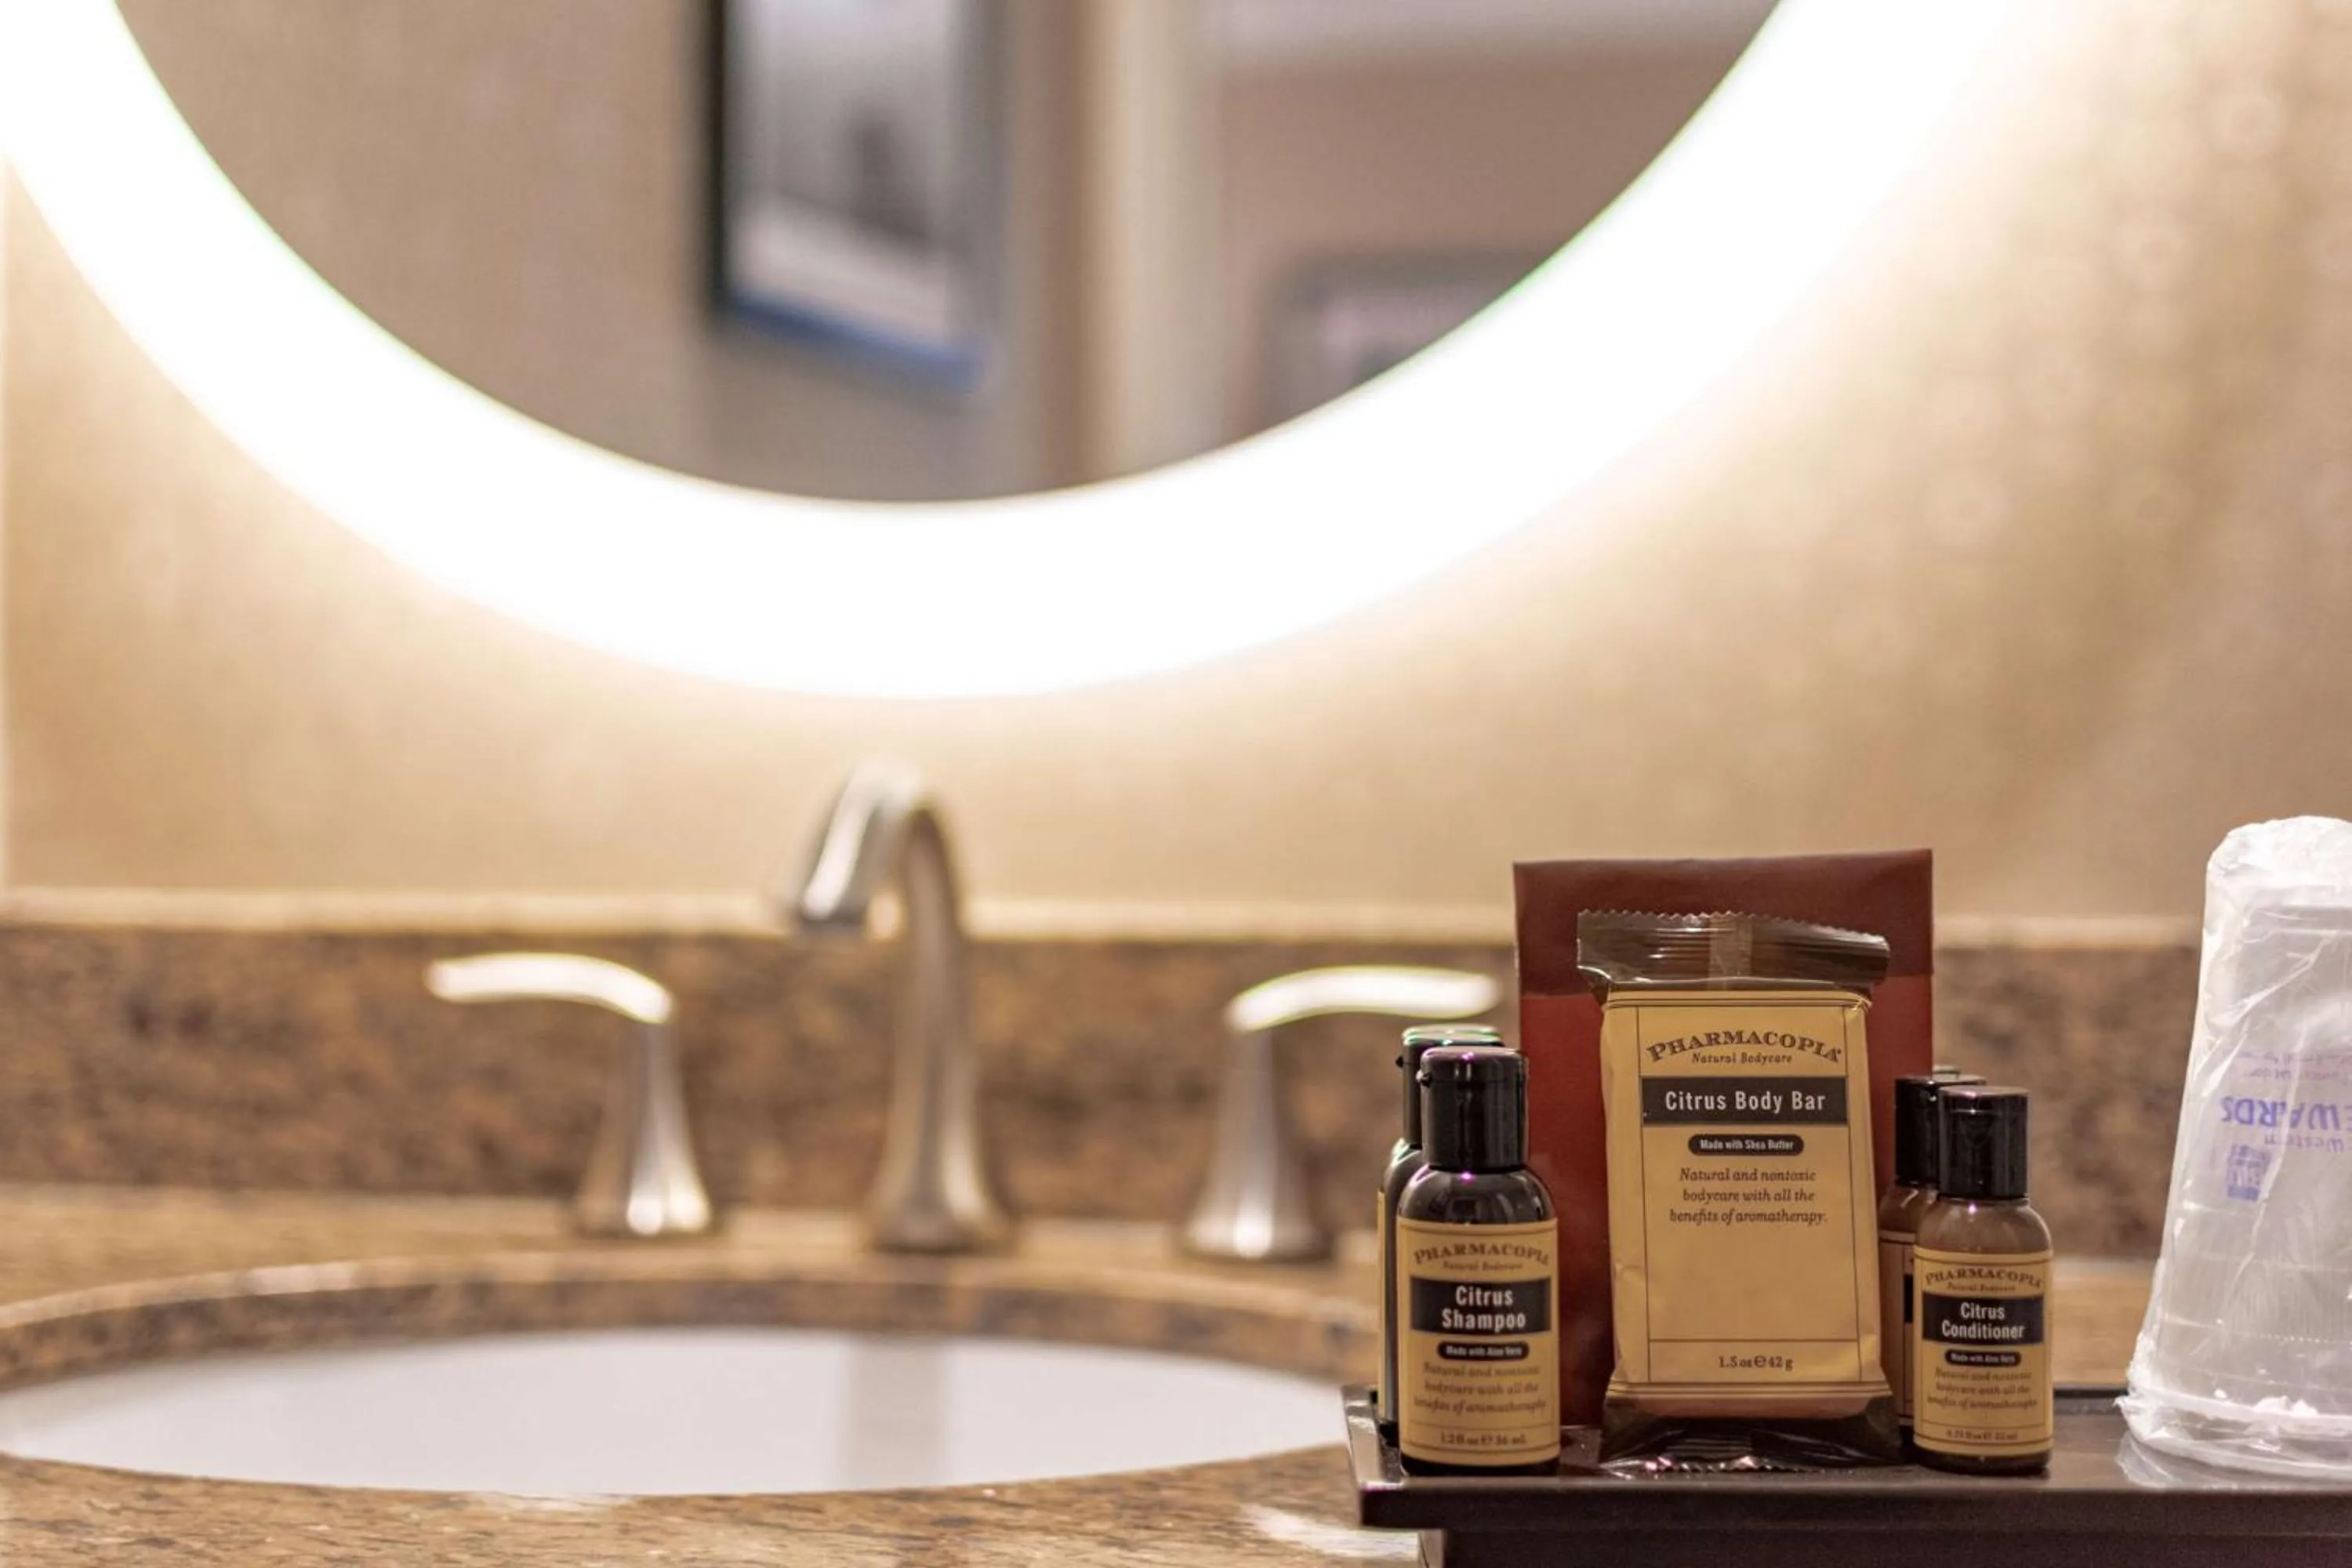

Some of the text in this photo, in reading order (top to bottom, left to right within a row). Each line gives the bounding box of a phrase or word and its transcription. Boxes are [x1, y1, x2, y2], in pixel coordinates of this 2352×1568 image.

[1646, 1030, 1838, 1063] PHARMACOPIA
[1690, 1051, 1793, 1067] Natural Bodycare
[1664, 1090, 1826, 1114] Citrus Body Bar
[1700, 1139, 1794, 1150] Made with Shea Butter
[1679, 1167, 1817, 1182] Natural and nontoxic
[1682, 1188, 1815, 1205] bodycare with all the
[1669, 1208, 1719, 1226] benefits
[1721, 1208, 1735, 1226] of
[1454, 1285, 1514, 1306] Citrus
[1960, 1301, 2005, 1320] Citrus
[1441, 1308, 1526, 1334] Shampoo
[1942, 1319, 2025, 1341] Conditioner
[1446, 1345, 1467, 1356] Made
[1468, 1345, 1485, 1357] with
[1719, 1355, 1738, 1369] 1.5
[1739, 1358, 1753, 1369] oz
[1784, 1358, 1794, 1372] g
